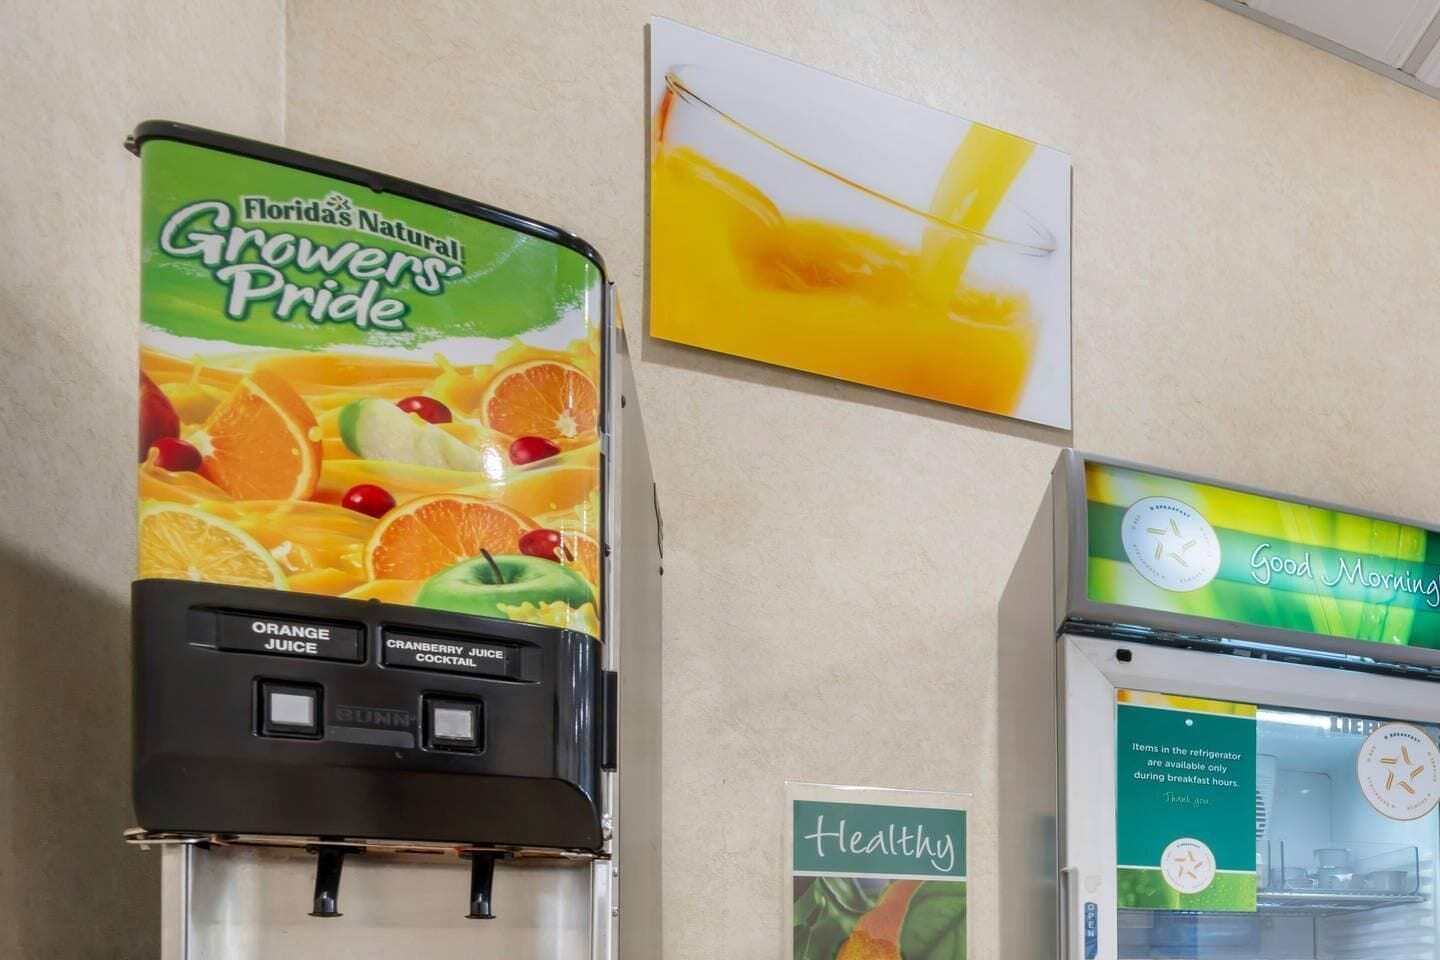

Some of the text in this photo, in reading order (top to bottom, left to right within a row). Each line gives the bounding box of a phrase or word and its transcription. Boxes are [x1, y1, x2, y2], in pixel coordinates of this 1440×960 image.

[216, 262, 405, 329] Pride
[1251, 543, 1312, 585] Good
[252, 621, 330, 640] ORANGE
[264, 638, 318, 654] JUICE
[386, 639, 503, 659] CRANBERRY JUICE
[415, 653, 477, 667] COCKTAIL
[335, 708, 410, 728] BUNN
[1132, 742, 1241, 761] Items in the refrigerator
[1147, 759, 1227, 774] are available only
[1134, 770, 1240, 787] during breakfast hours.
[804, 815, 955, 872] Healthy
[1087, 903, 1095, 937] OPEN
